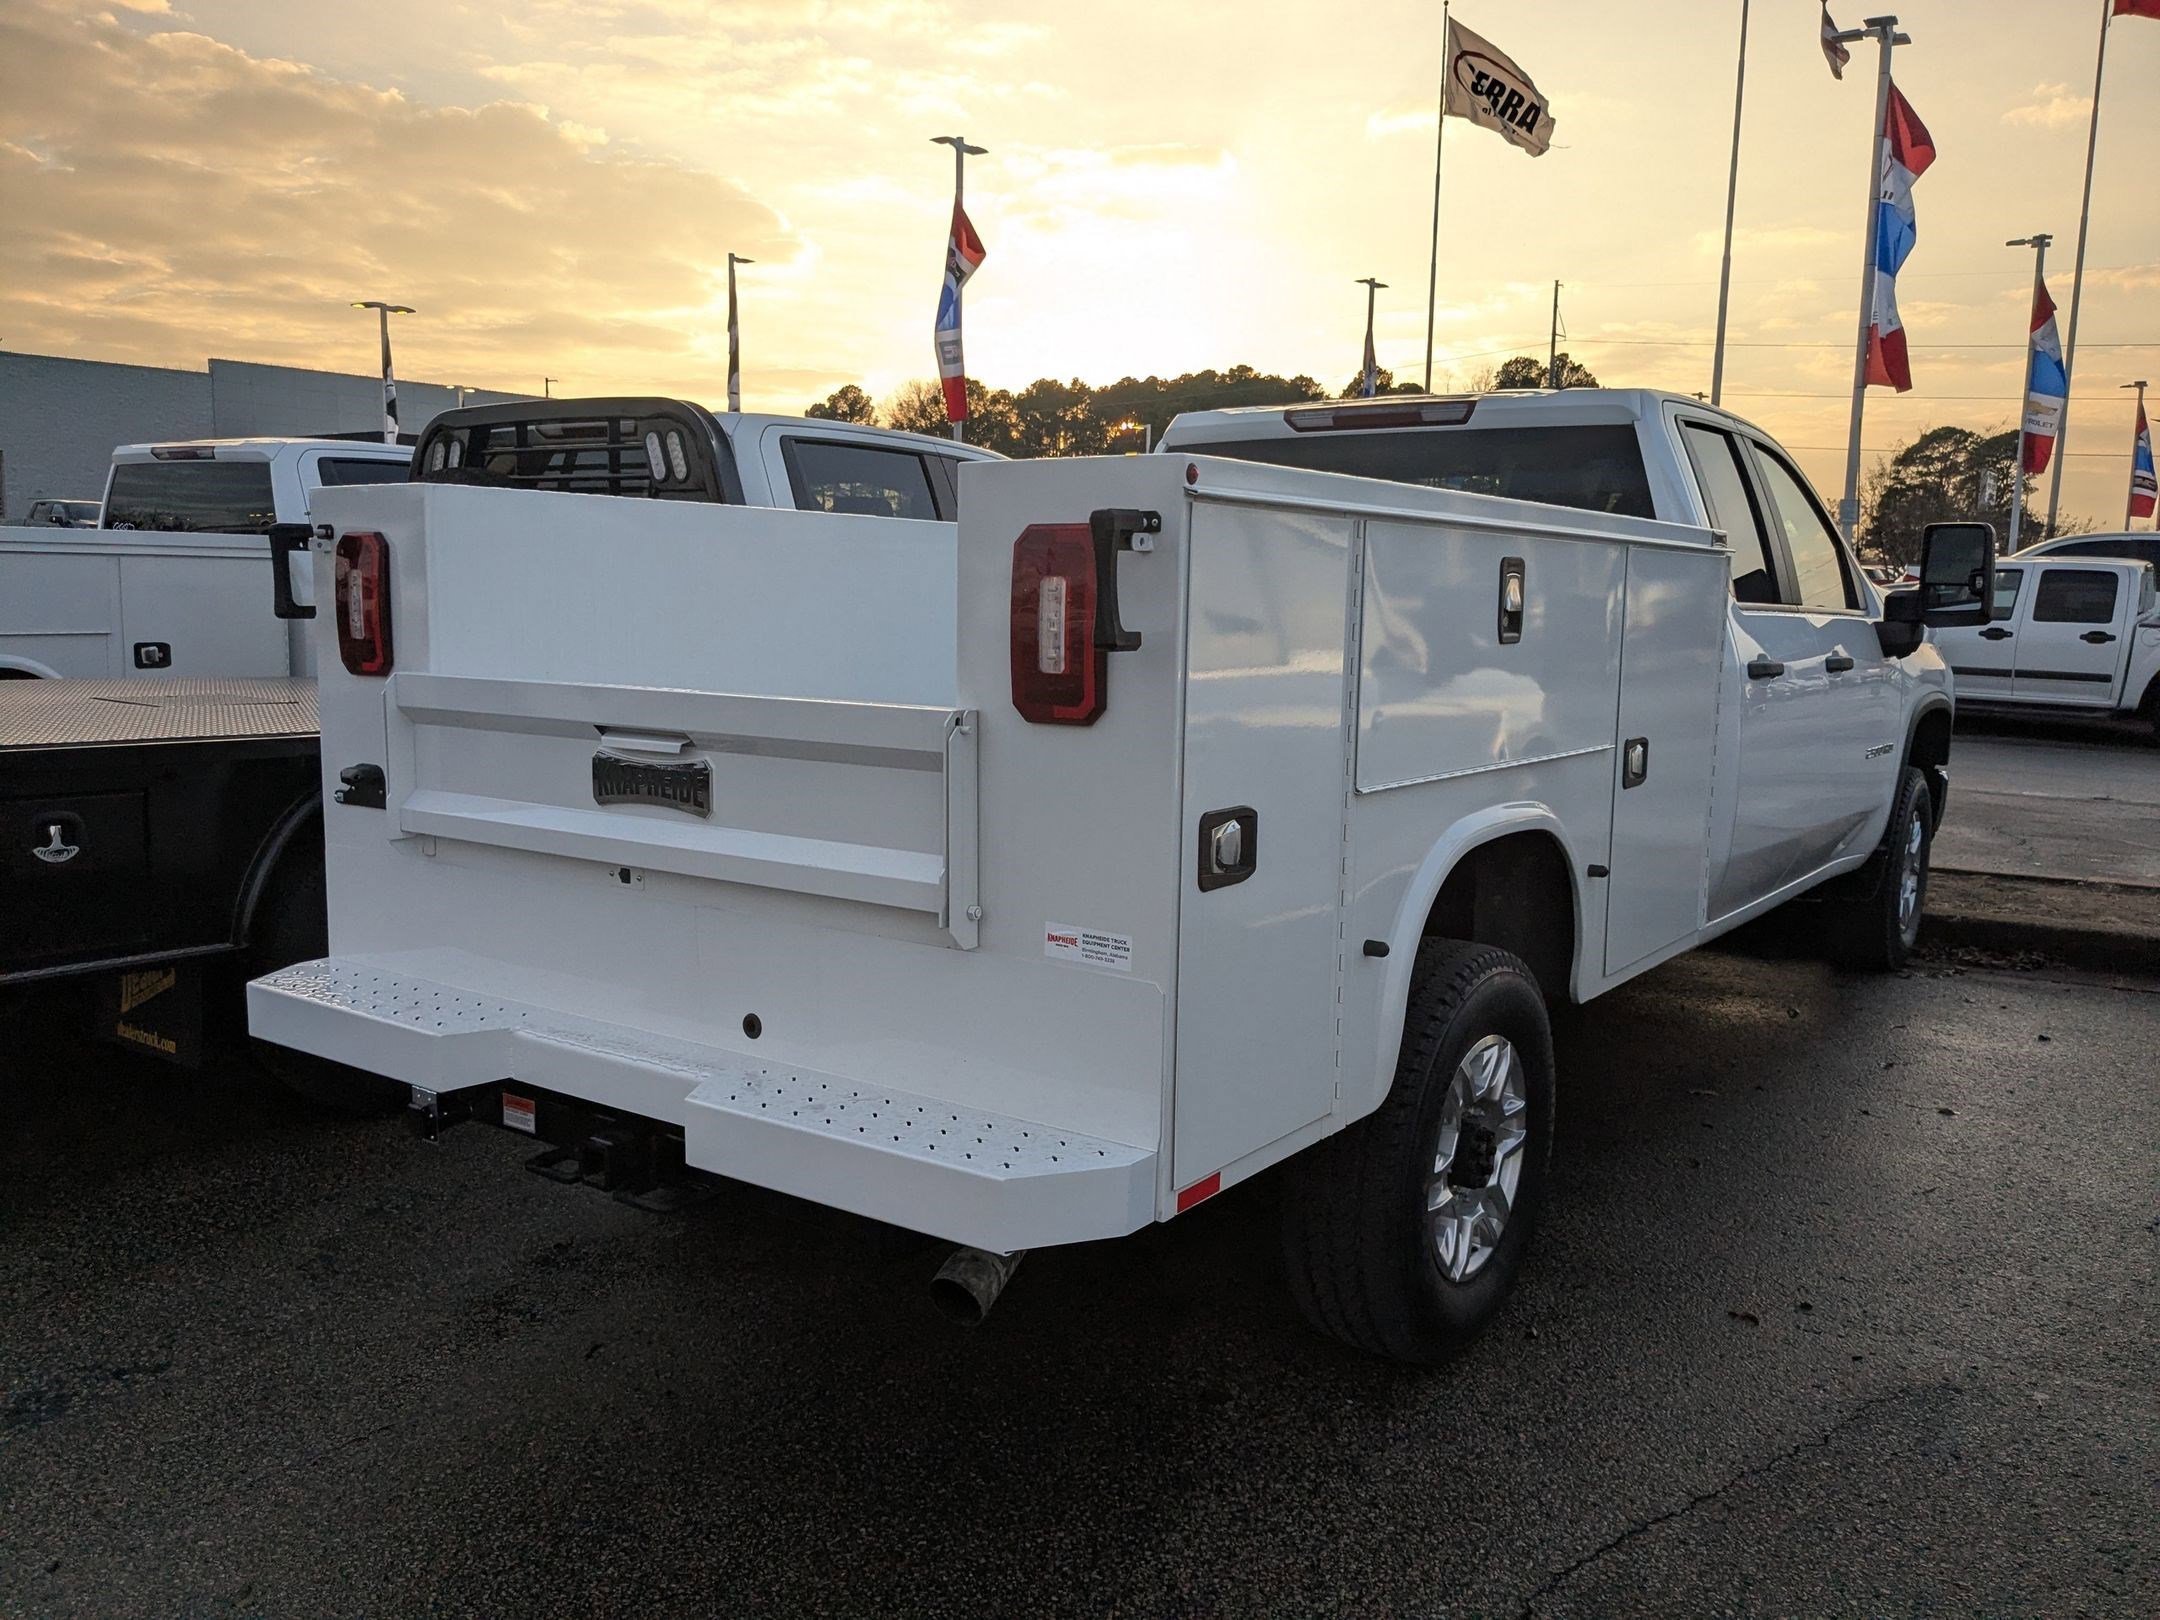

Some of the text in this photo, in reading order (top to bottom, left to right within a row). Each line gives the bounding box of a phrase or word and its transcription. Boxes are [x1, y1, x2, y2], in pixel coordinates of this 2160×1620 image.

[1047, 932, 1078, 947] KNAPHEIDE
[1082, 933, 1127, 946] KNAPHEIDE TRUCK
[1082, 940, 1130, 952] EQUIPMENT CENTER
